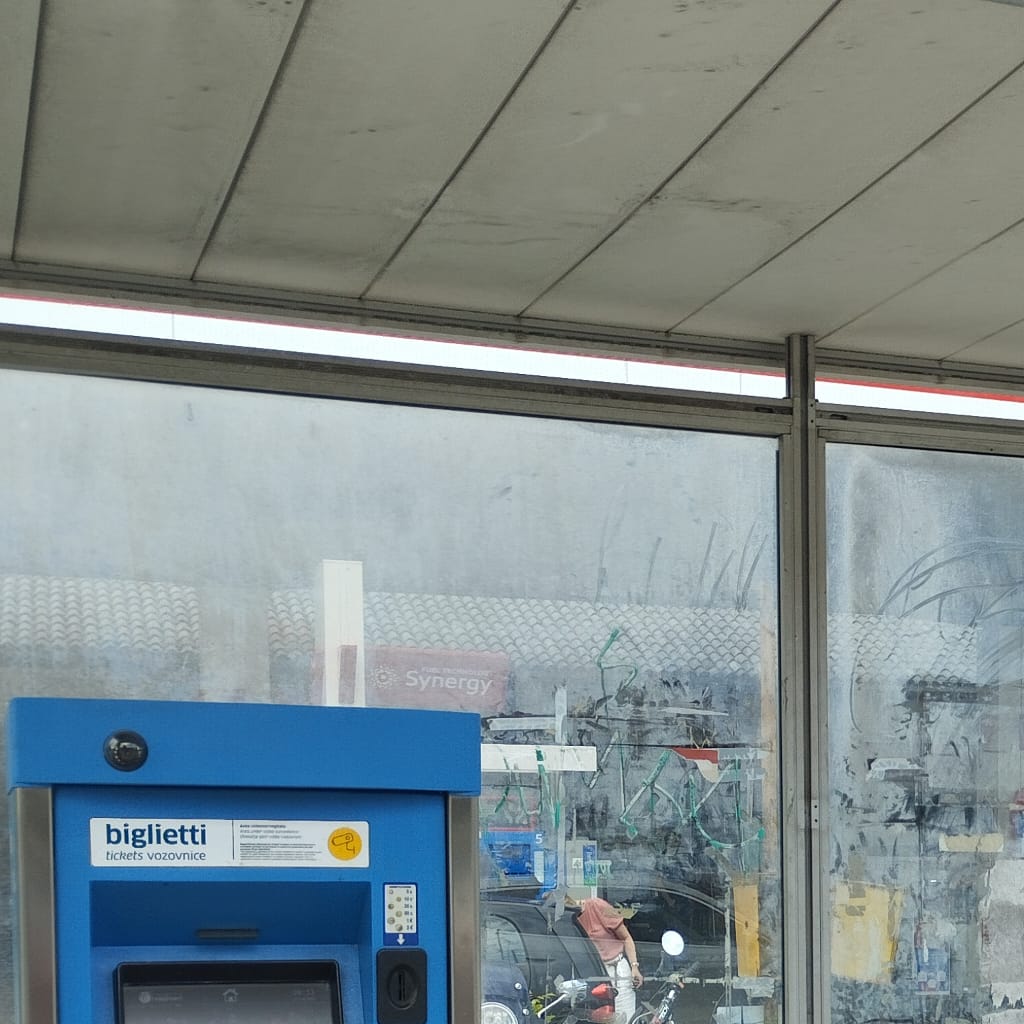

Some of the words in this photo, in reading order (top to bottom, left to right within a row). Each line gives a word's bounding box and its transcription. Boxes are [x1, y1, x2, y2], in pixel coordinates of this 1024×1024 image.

[405, 670, 493, 695] Synergy
[106, 823, 206, 848] biglietti
[535, 833, 543, 844] 5
[106, 850, 143, 861] tickets
[147, 850, 206, 861] vozovnice
